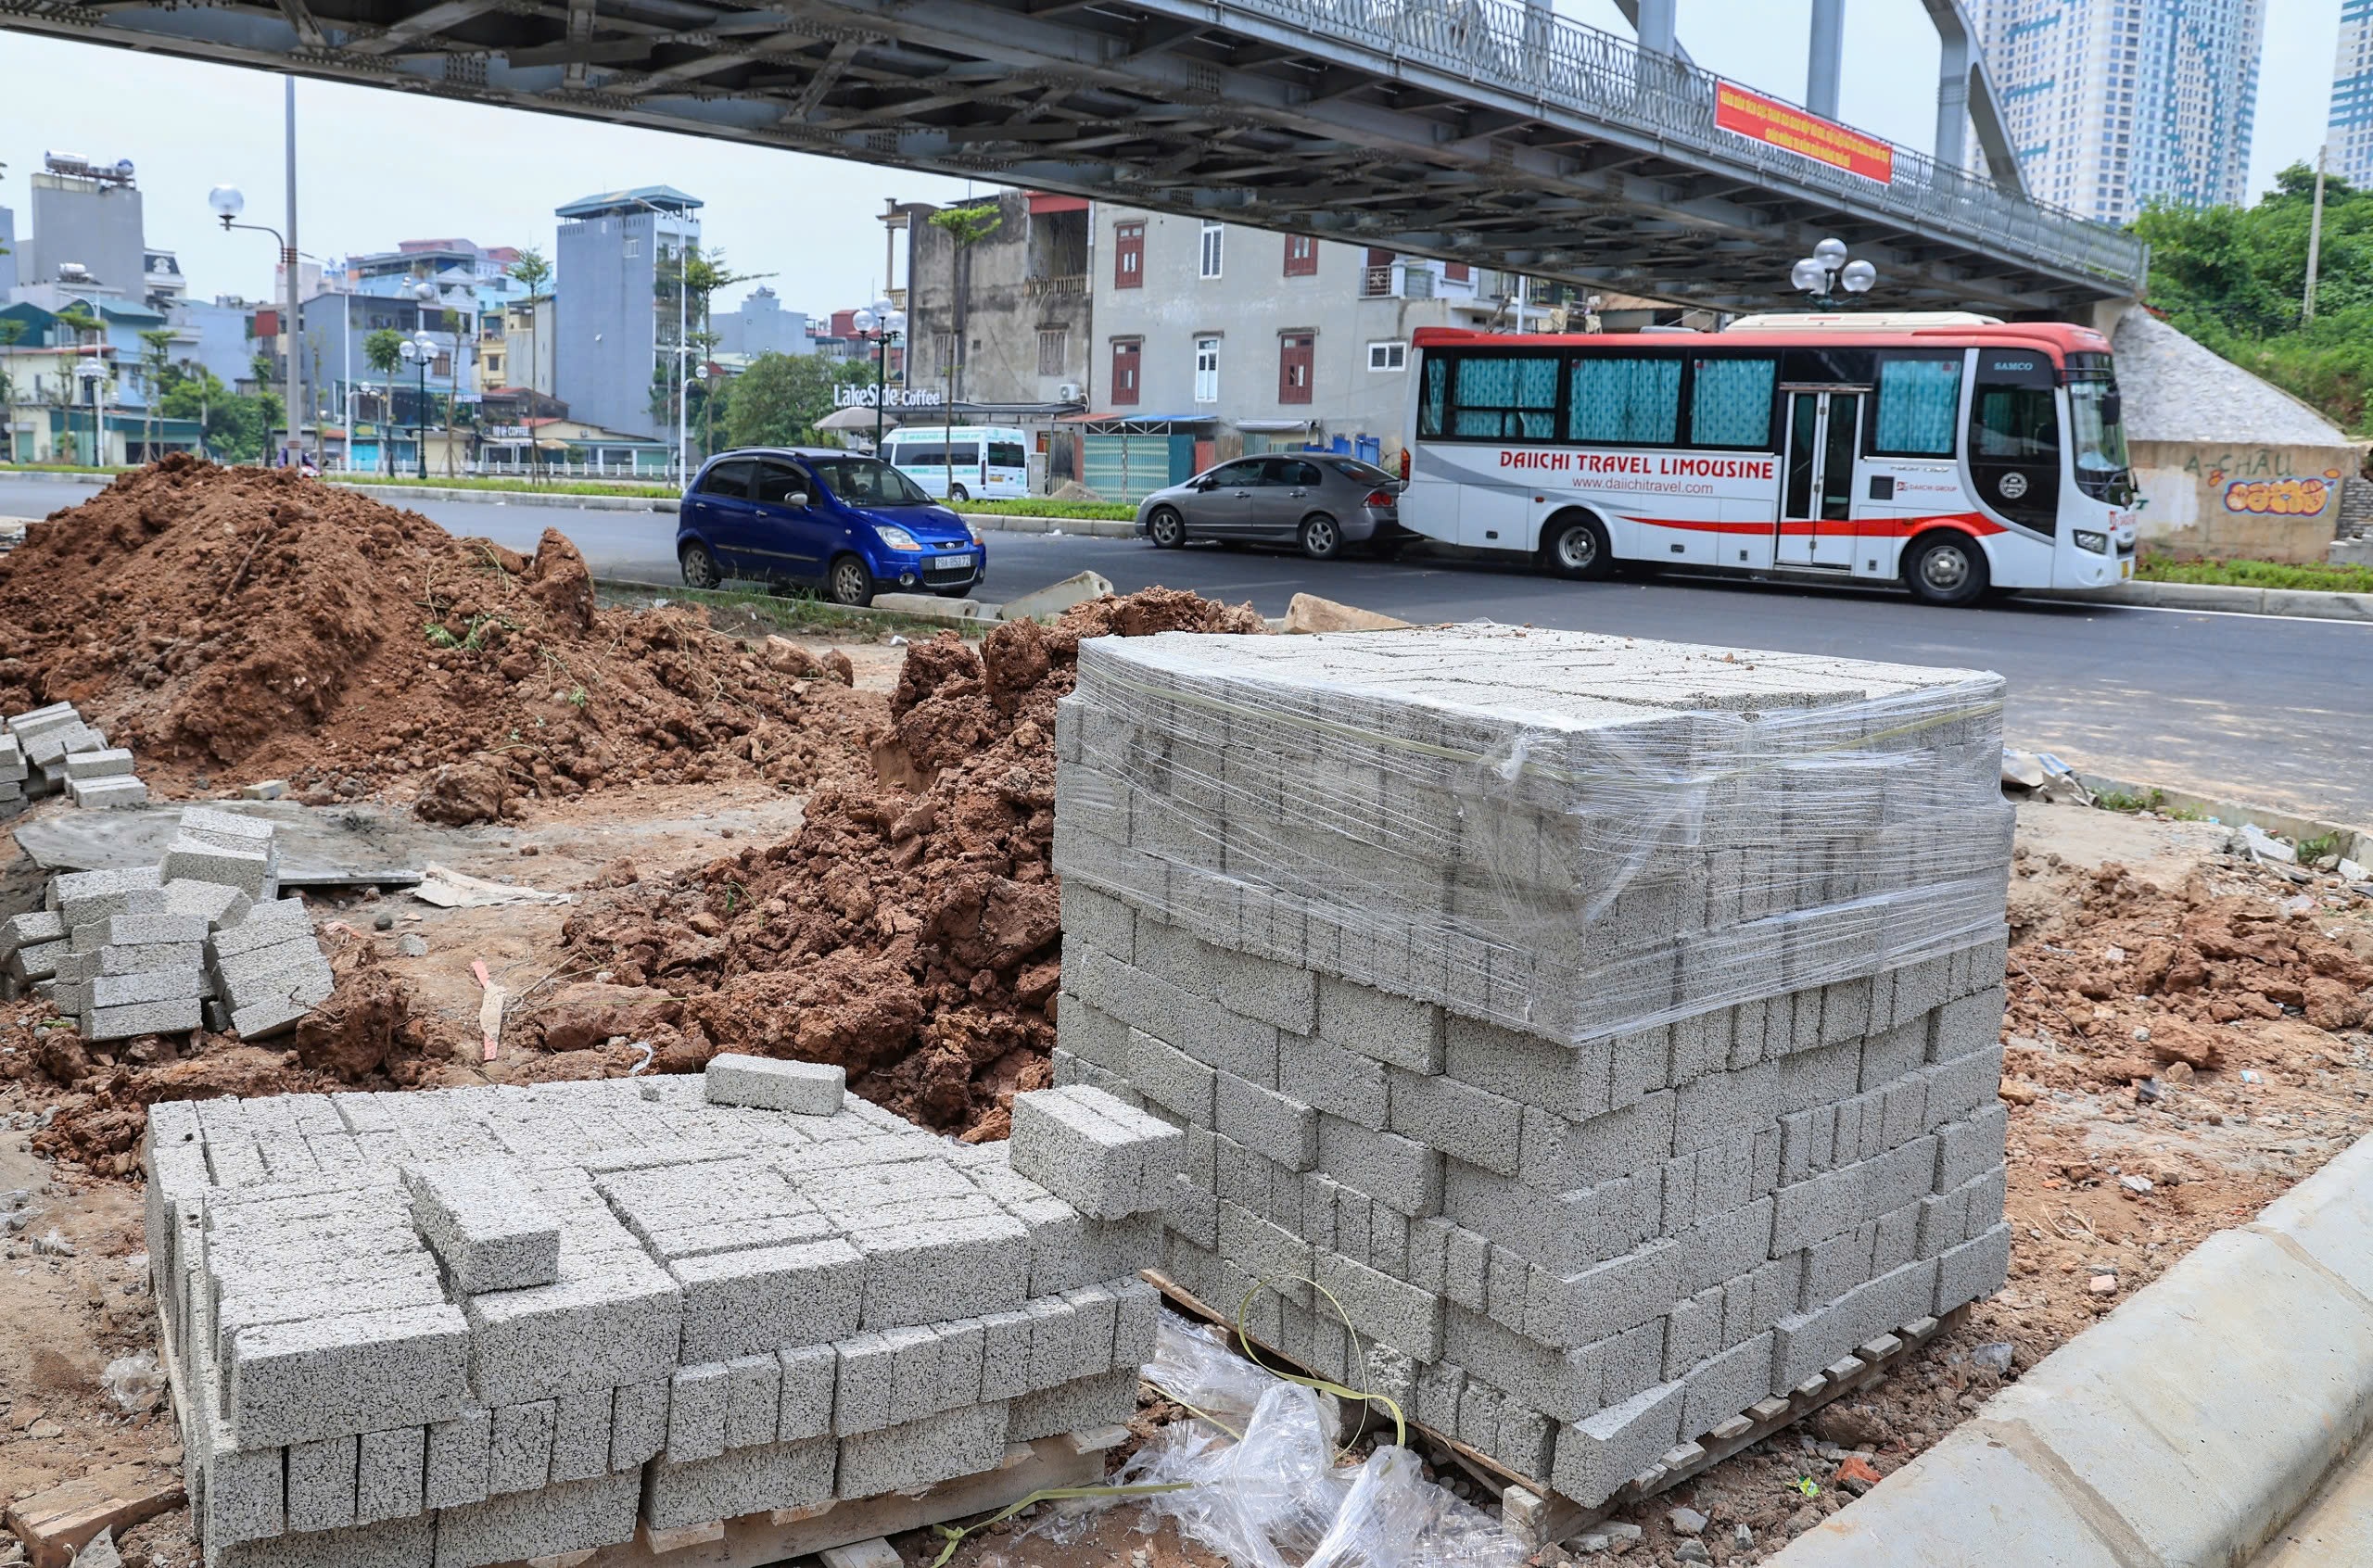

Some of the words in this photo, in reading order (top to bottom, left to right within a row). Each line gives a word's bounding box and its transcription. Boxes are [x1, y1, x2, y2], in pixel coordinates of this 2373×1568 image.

[902, 389, 940, 406] Coffee
[1500, 450, 1570, 471] DAIICHI
[1576, 454, 1652, 474] TRAVEL
[1660, 458, 1774, 480] LIMOUSINE
[1572, 476, 1715, 494] www.daiichitravel.com
